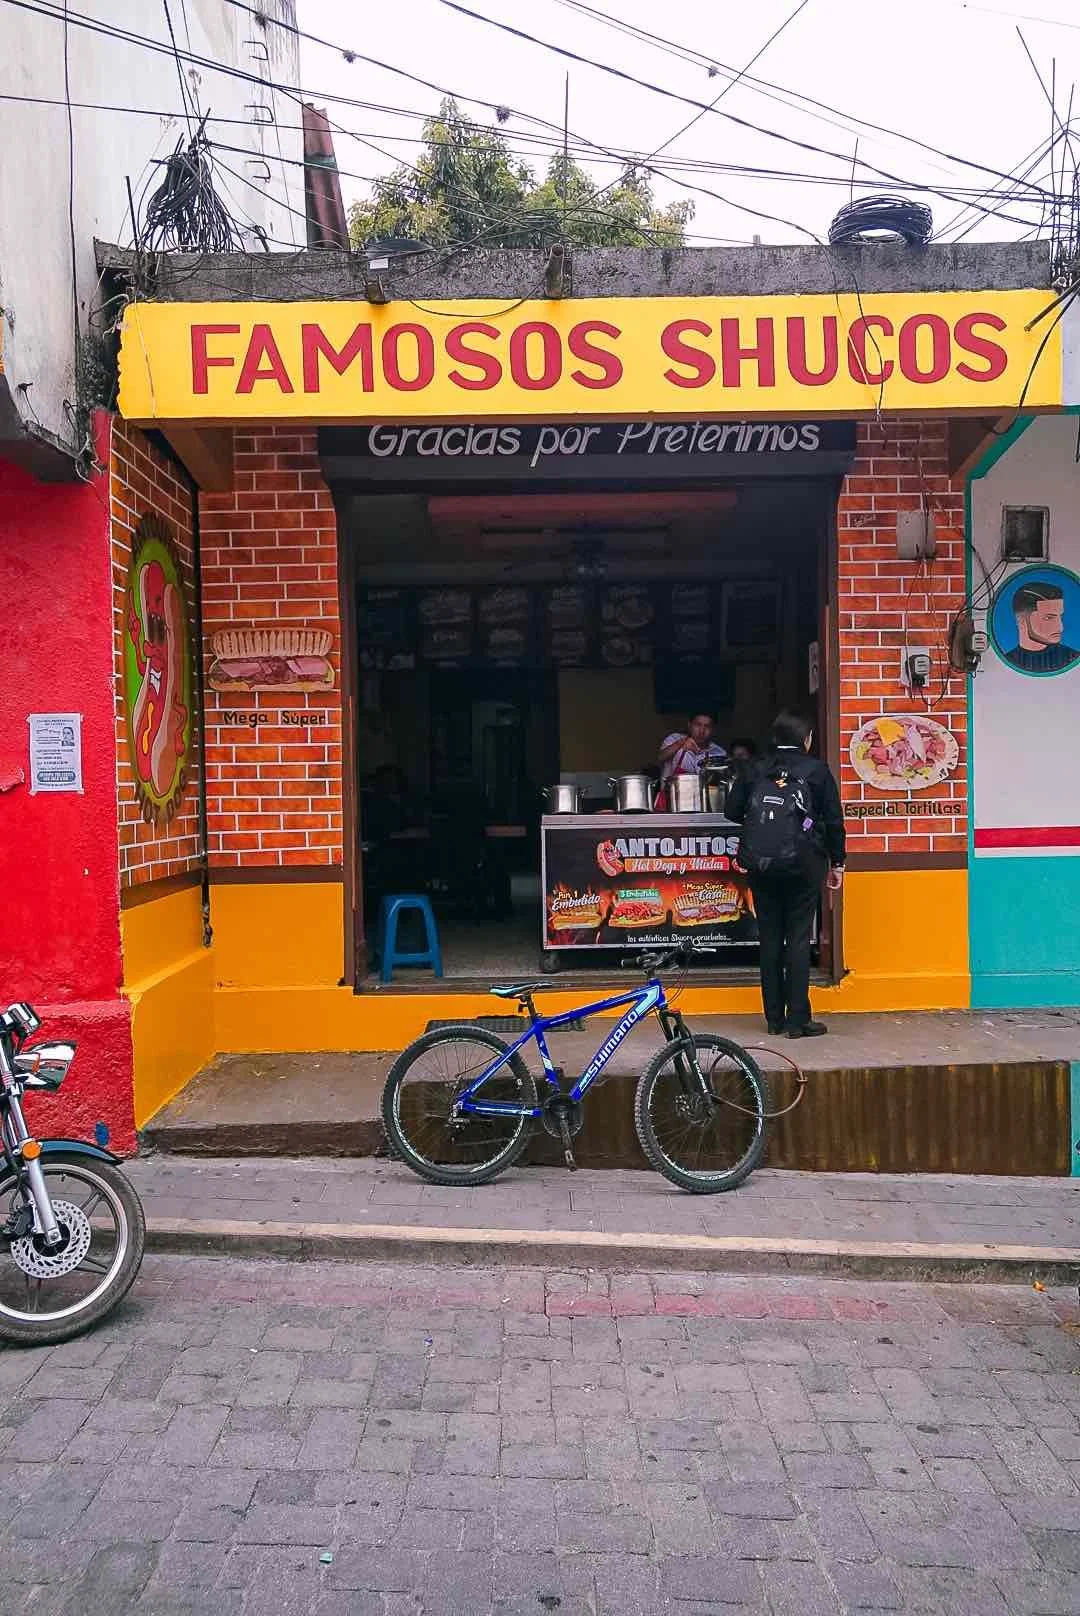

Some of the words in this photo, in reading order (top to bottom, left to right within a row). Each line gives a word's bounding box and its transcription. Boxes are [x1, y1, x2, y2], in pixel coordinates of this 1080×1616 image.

[190, 319, 624, 395] FAMOSOS
[660, 312, 1009, 390] SHUCOS
[368, 422, 521, 458] Gracias
[530, 424, 601, 468] por
[223, 710, 269, 728] Mega
[844, 801, 898, 819] Especial
[905, 800, 961, 816] Tortillas
[614, 836, 740, 857] ANTOJITOS
[631, 858, 650, 871] Hot
[654, 858, 677, 875] Dogs
[679, 861, 688, 875] y
[689, 857, 724, 871] Mixtas
[686, 883, 704, 891] Mega
[551, 893, 601, 912] Embutido
[587, 1011, 639, 1077] SHIMANO
